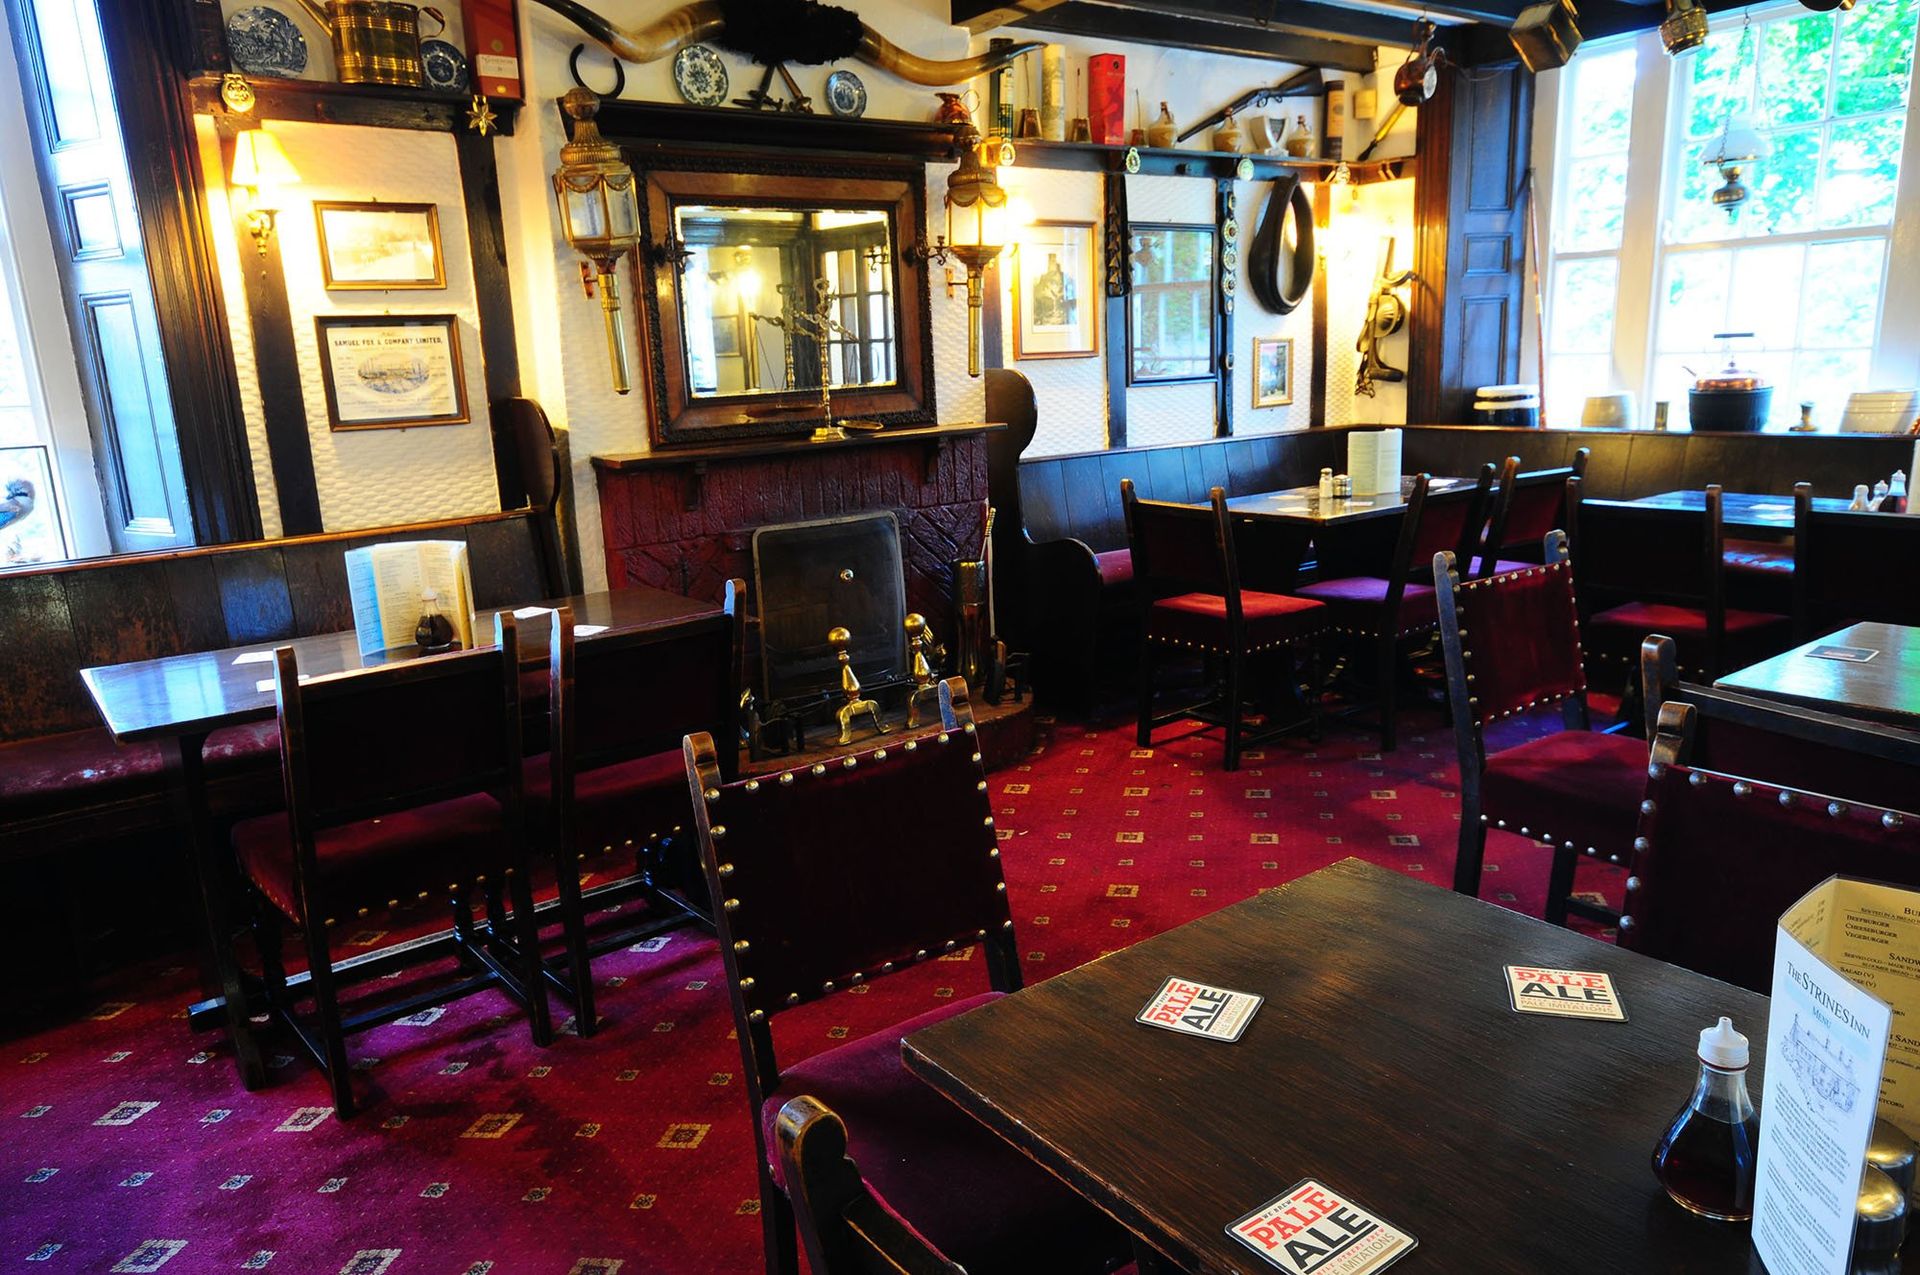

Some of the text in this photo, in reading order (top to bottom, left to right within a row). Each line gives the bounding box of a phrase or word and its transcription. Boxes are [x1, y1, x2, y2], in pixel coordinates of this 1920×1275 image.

[1514, 971, 1606, 989] PALE
[1520, 982, 1611, 1001] ALE
[1787, 961, 1870, 1039] THE STRINES INN
[1154, 983, 1200, 1025] PALE
[1181, 989, 1227, 1030] ALE
[1813, 1006, 1832, 1029] MENU
[1248, 1191, 1341, 1250] PALE
[1284, 1206, 1371, 1270] ALE
[1340, 1232, 1396, 1273] IMITATIONS
